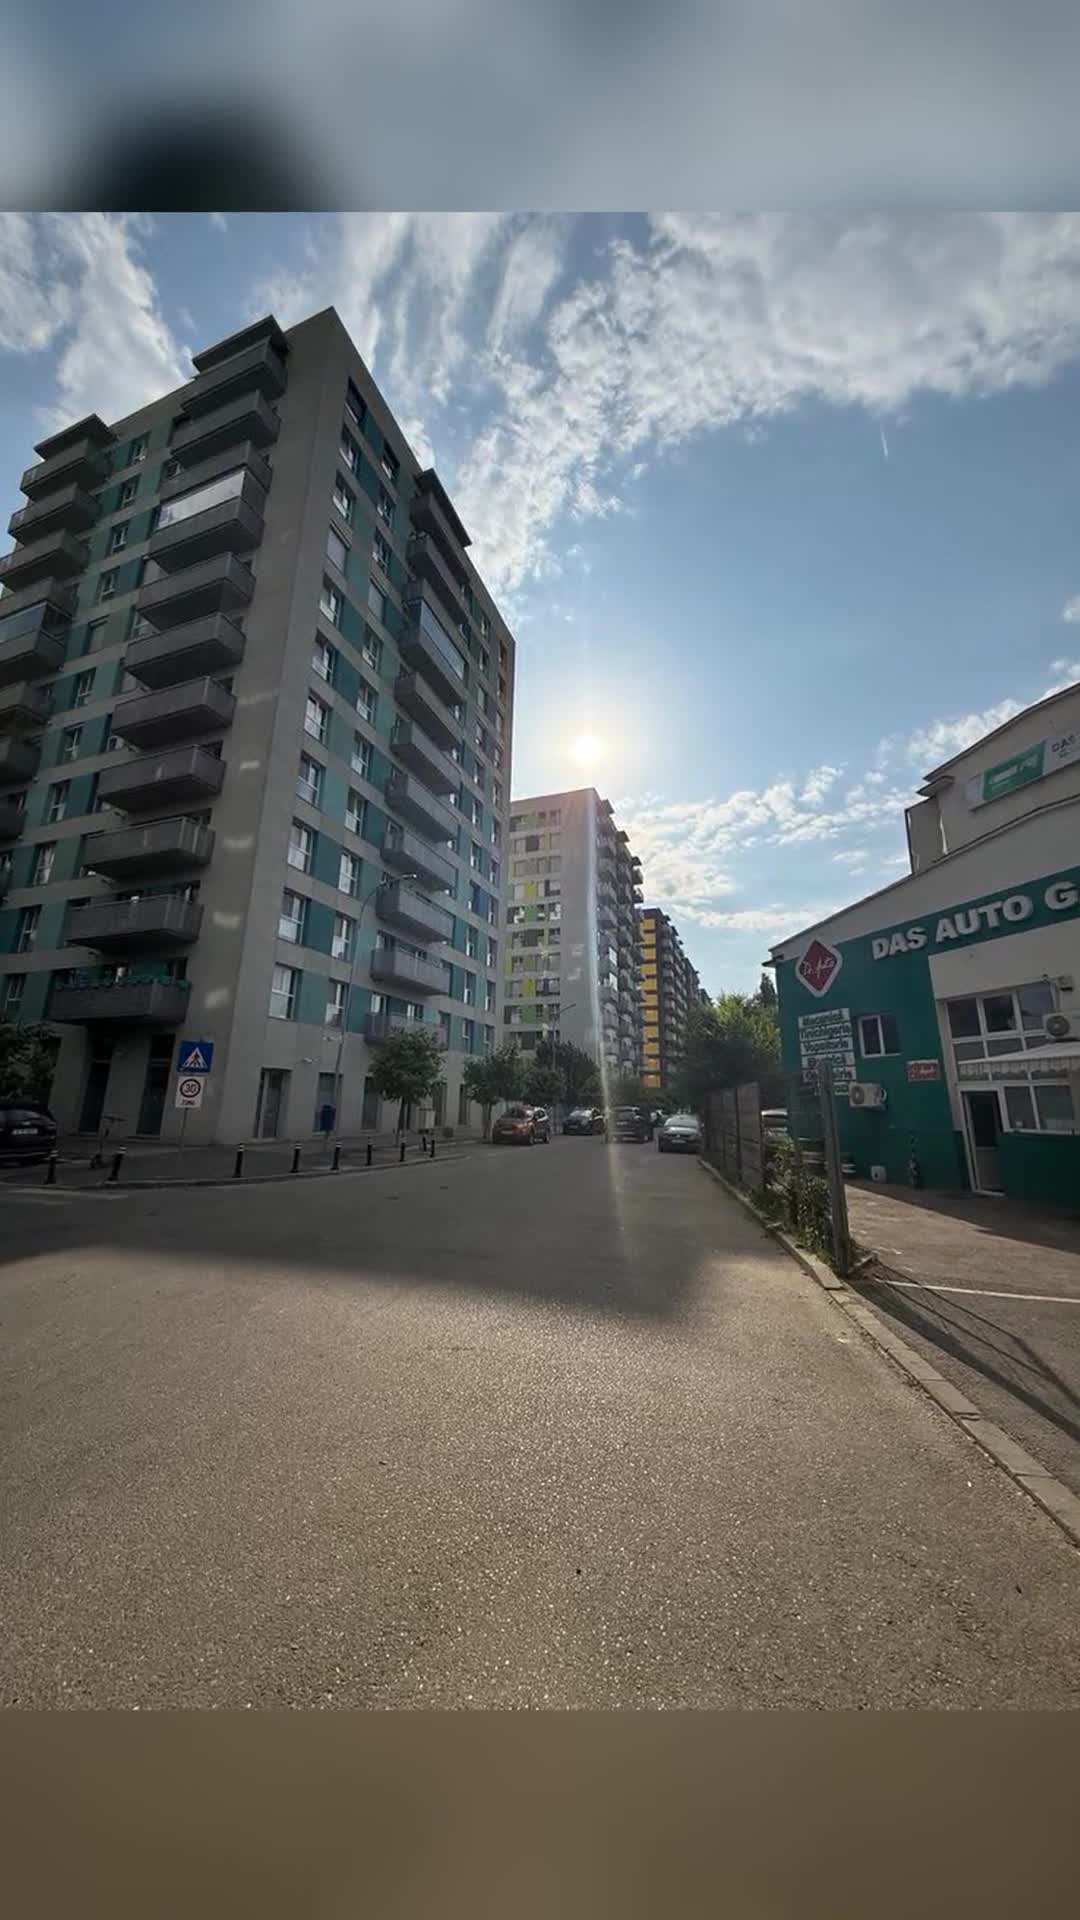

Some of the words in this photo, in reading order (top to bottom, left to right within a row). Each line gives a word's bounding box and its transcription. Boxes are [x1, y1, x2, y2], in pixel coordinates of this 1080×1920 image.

[871, 928, 928, 960] DAS
[935, 895, 1033, 943] AUTO
[184, 1083, 197, 1094] 30
